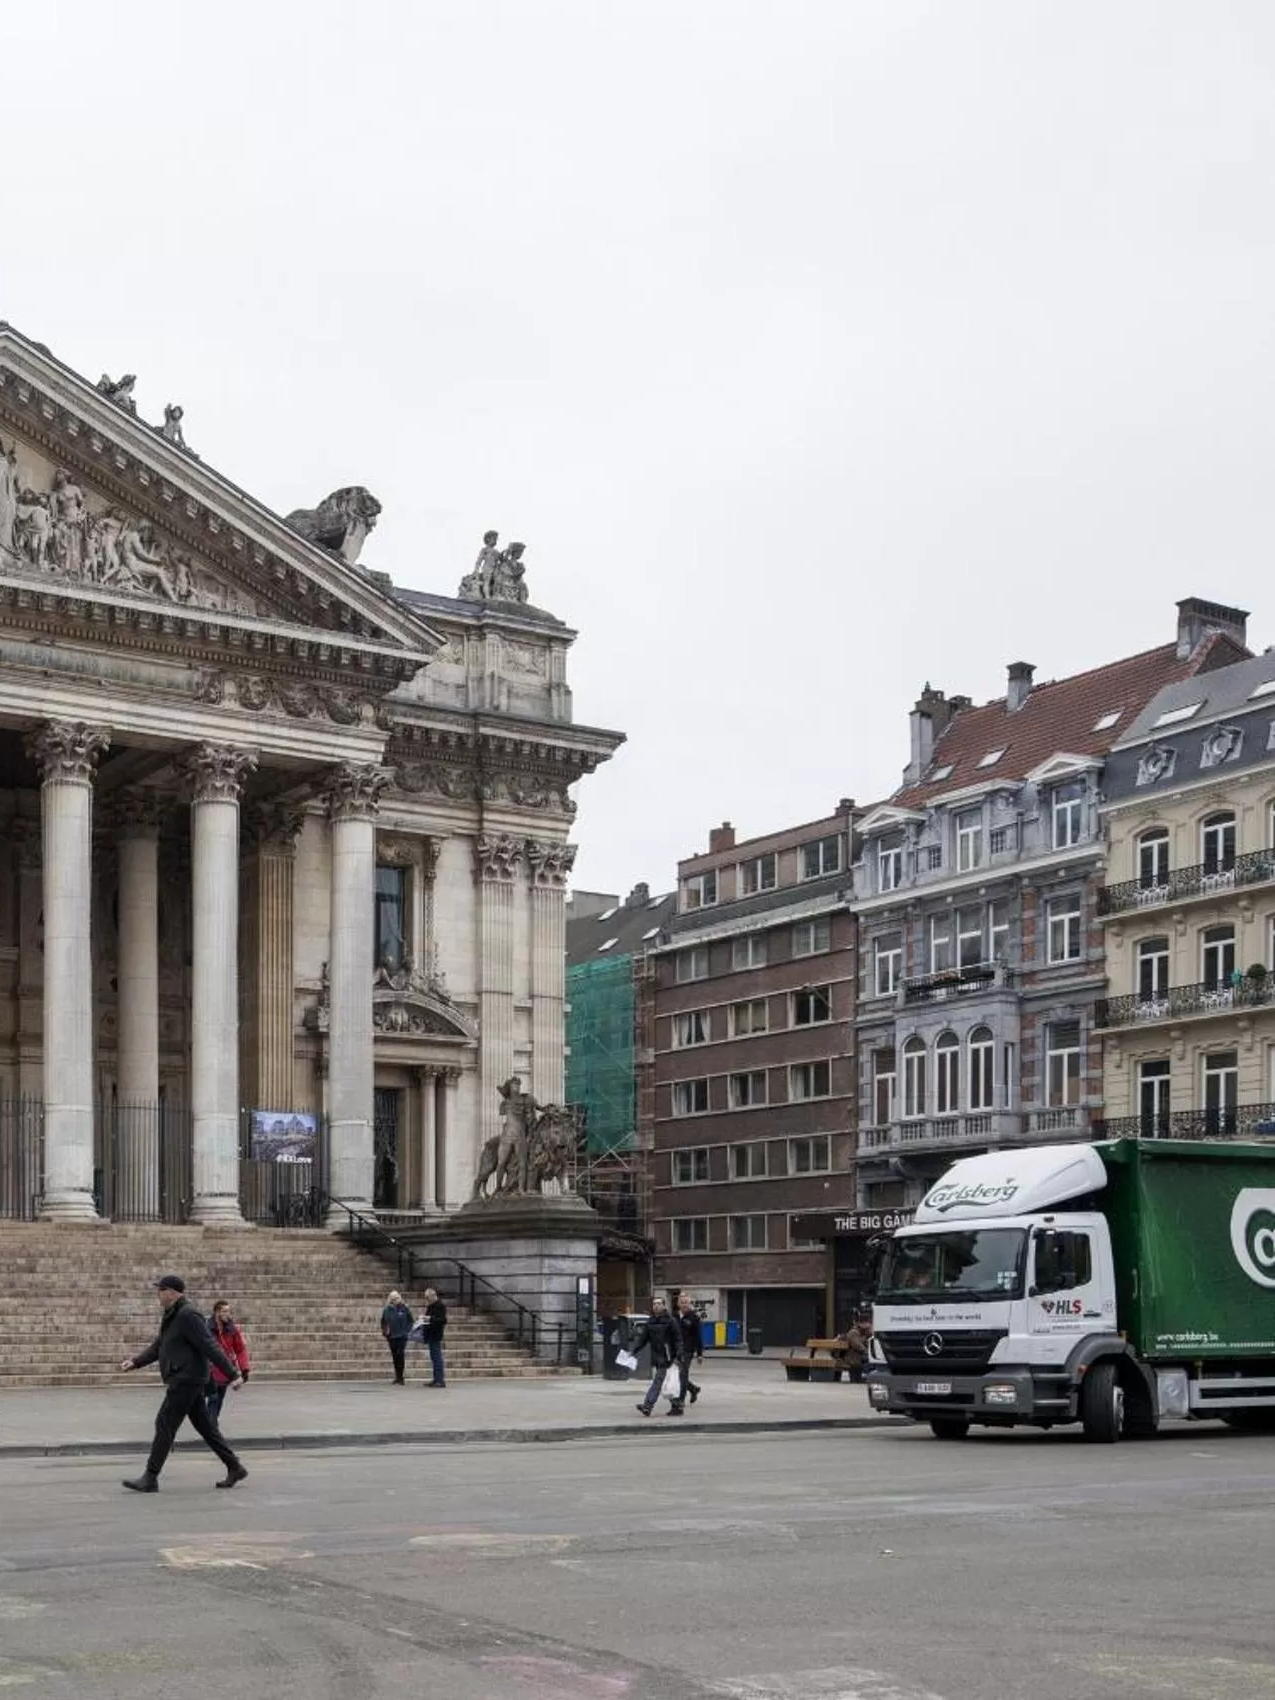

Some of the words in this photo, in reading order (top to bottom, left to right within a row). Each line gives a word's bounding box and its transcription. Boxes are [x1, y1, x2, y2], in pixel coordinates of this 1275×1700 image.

[924, 1180, 1019, 1210] Carlsberg
[834, 1216, 858, 1231] THE
[860, 1215, 881, 1229] BIG
[1056, 1299, 1082, 1315] HLS
